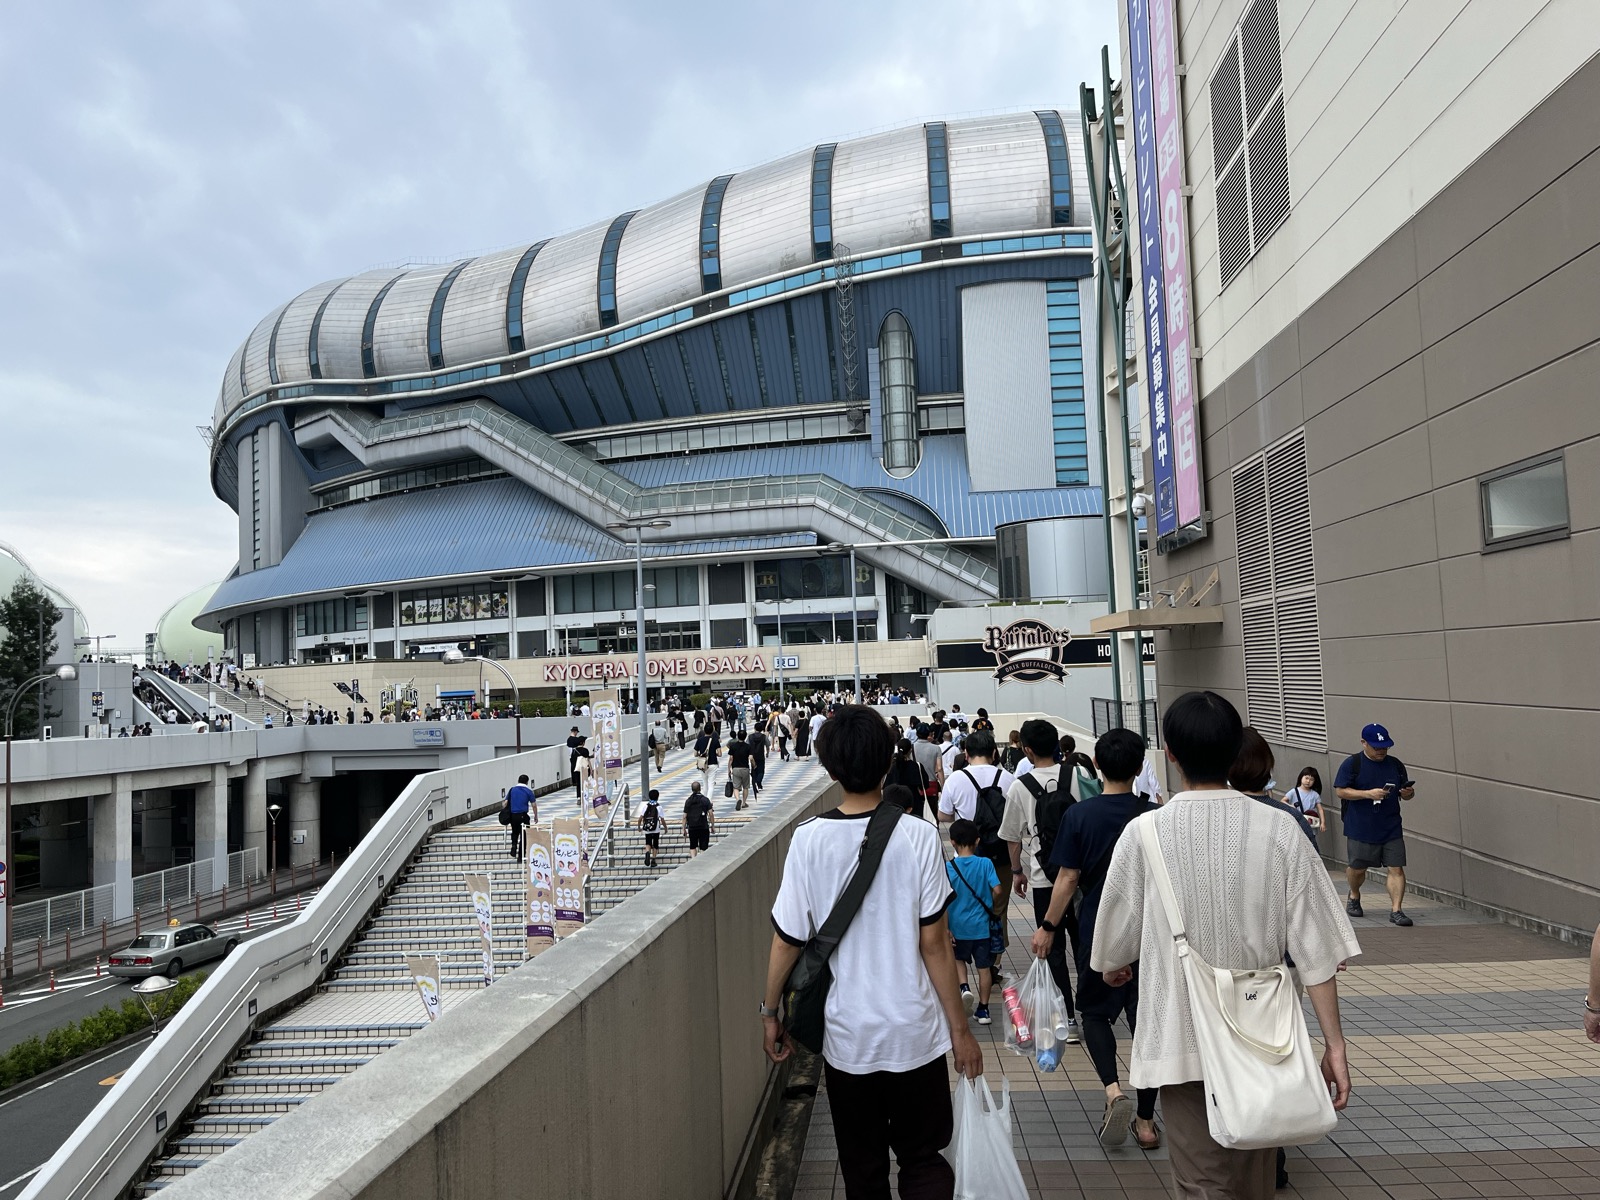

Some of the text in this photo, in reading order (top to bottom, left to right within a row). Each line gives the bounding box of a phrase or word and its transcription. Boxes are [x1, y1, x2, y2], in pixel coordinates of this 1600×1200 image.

[1164, 189, 1195, 471] 8時開店
[1148, 275, 1169, 467] 会員募集中
[985, 625, 1069, 651] Buffaloes
[543, 661, 628, 681] KYOCERA
[692, 655, 767, 674] OSAKA
[776, 658, 796, 667] 東口
[1005, 661, 1056, 673] ORIX BUFFALOES
[1245, 992, 1257, 1001] Lee
